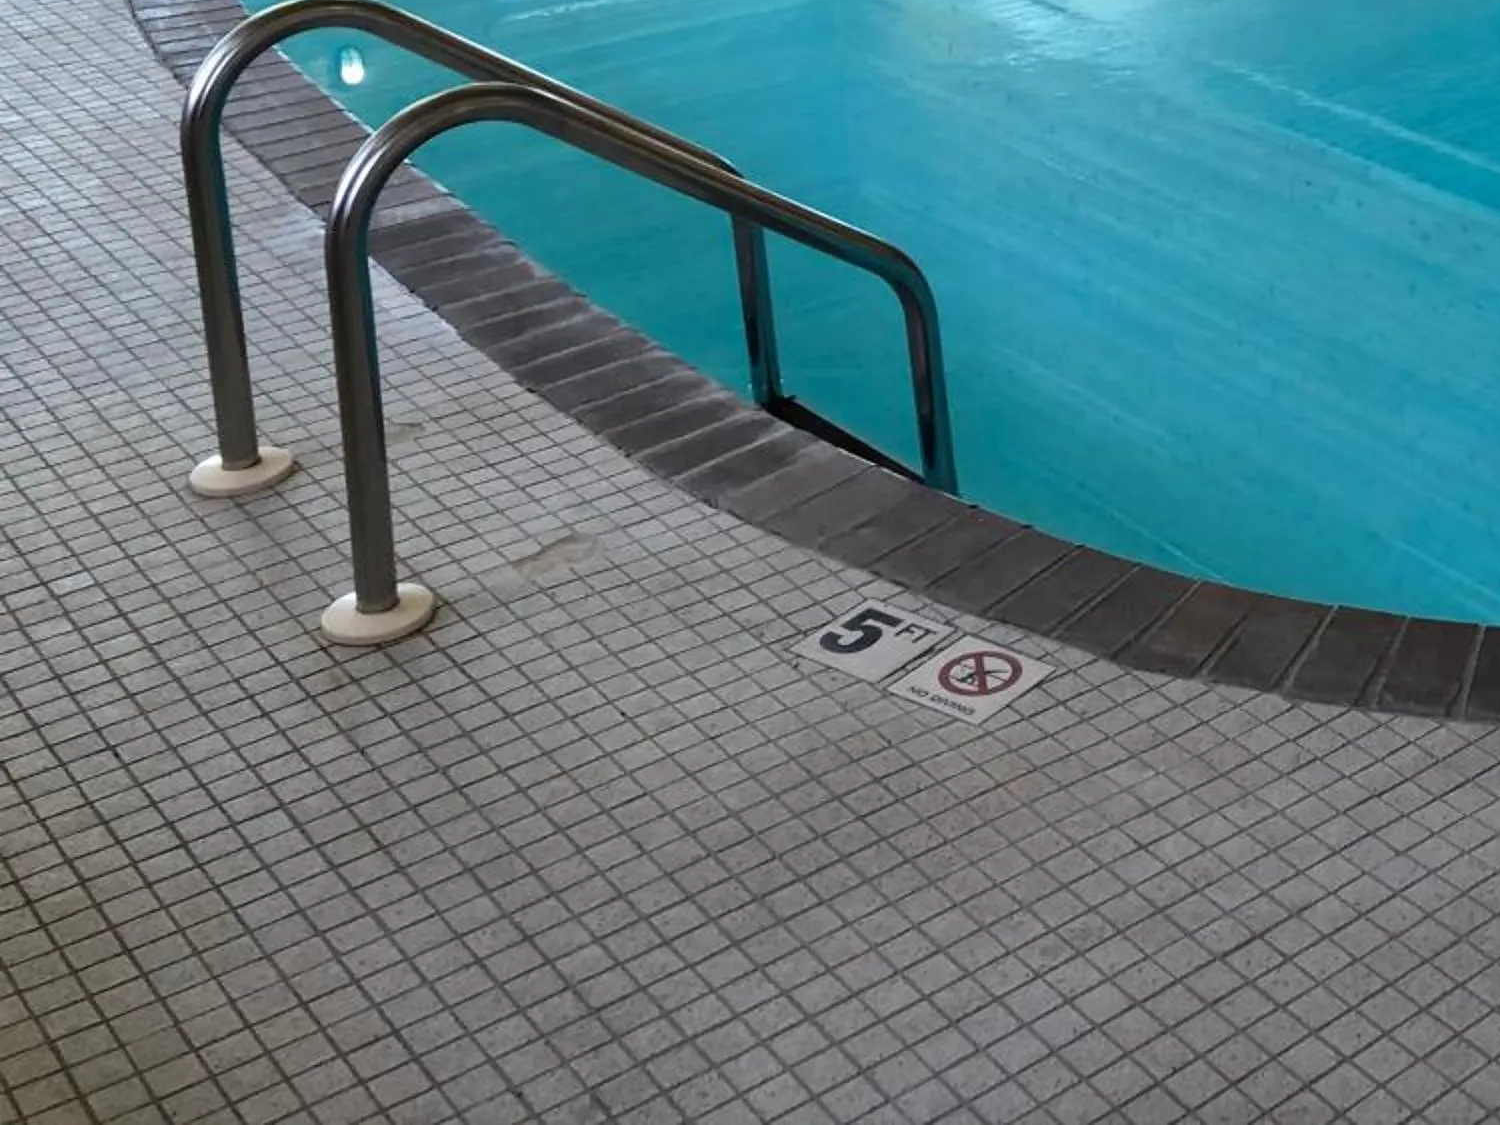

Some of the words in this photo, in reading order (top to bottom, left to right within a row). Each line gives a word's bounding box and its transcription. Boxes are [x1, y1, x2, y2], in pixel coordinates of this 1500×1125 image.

[819, 608, 906, 654] 5
[894, 622, 937, 644] FT
[907, 686, 929, 698] NO
[929, 694, 976, 716] DIVING
